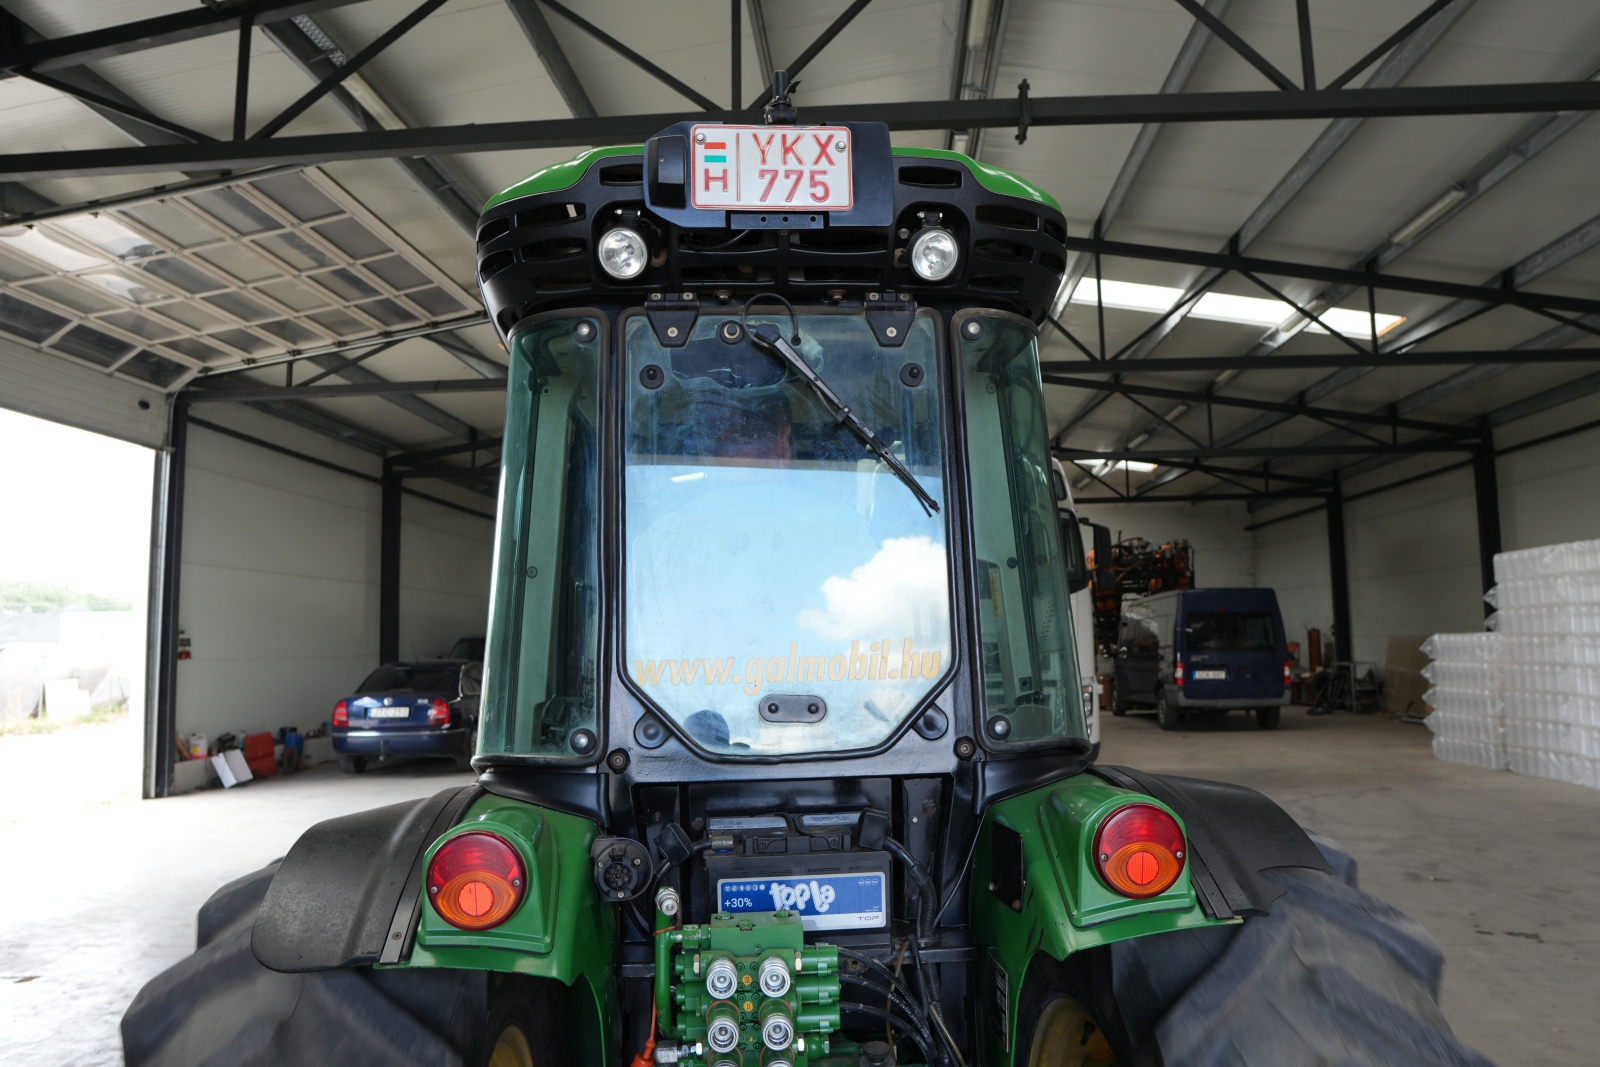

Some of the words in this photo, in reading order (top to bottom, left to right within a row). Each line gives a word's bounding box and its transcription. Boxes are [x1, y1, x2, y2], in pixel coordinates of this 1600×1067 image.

[752, 133, 836, 166] YKX
[704, 168, 728, 192] H
[758, 169, 831, 203] 775
[634, 638, 941, 696] www.galmobil.hu
[724, 898, 752, 907] +30%
